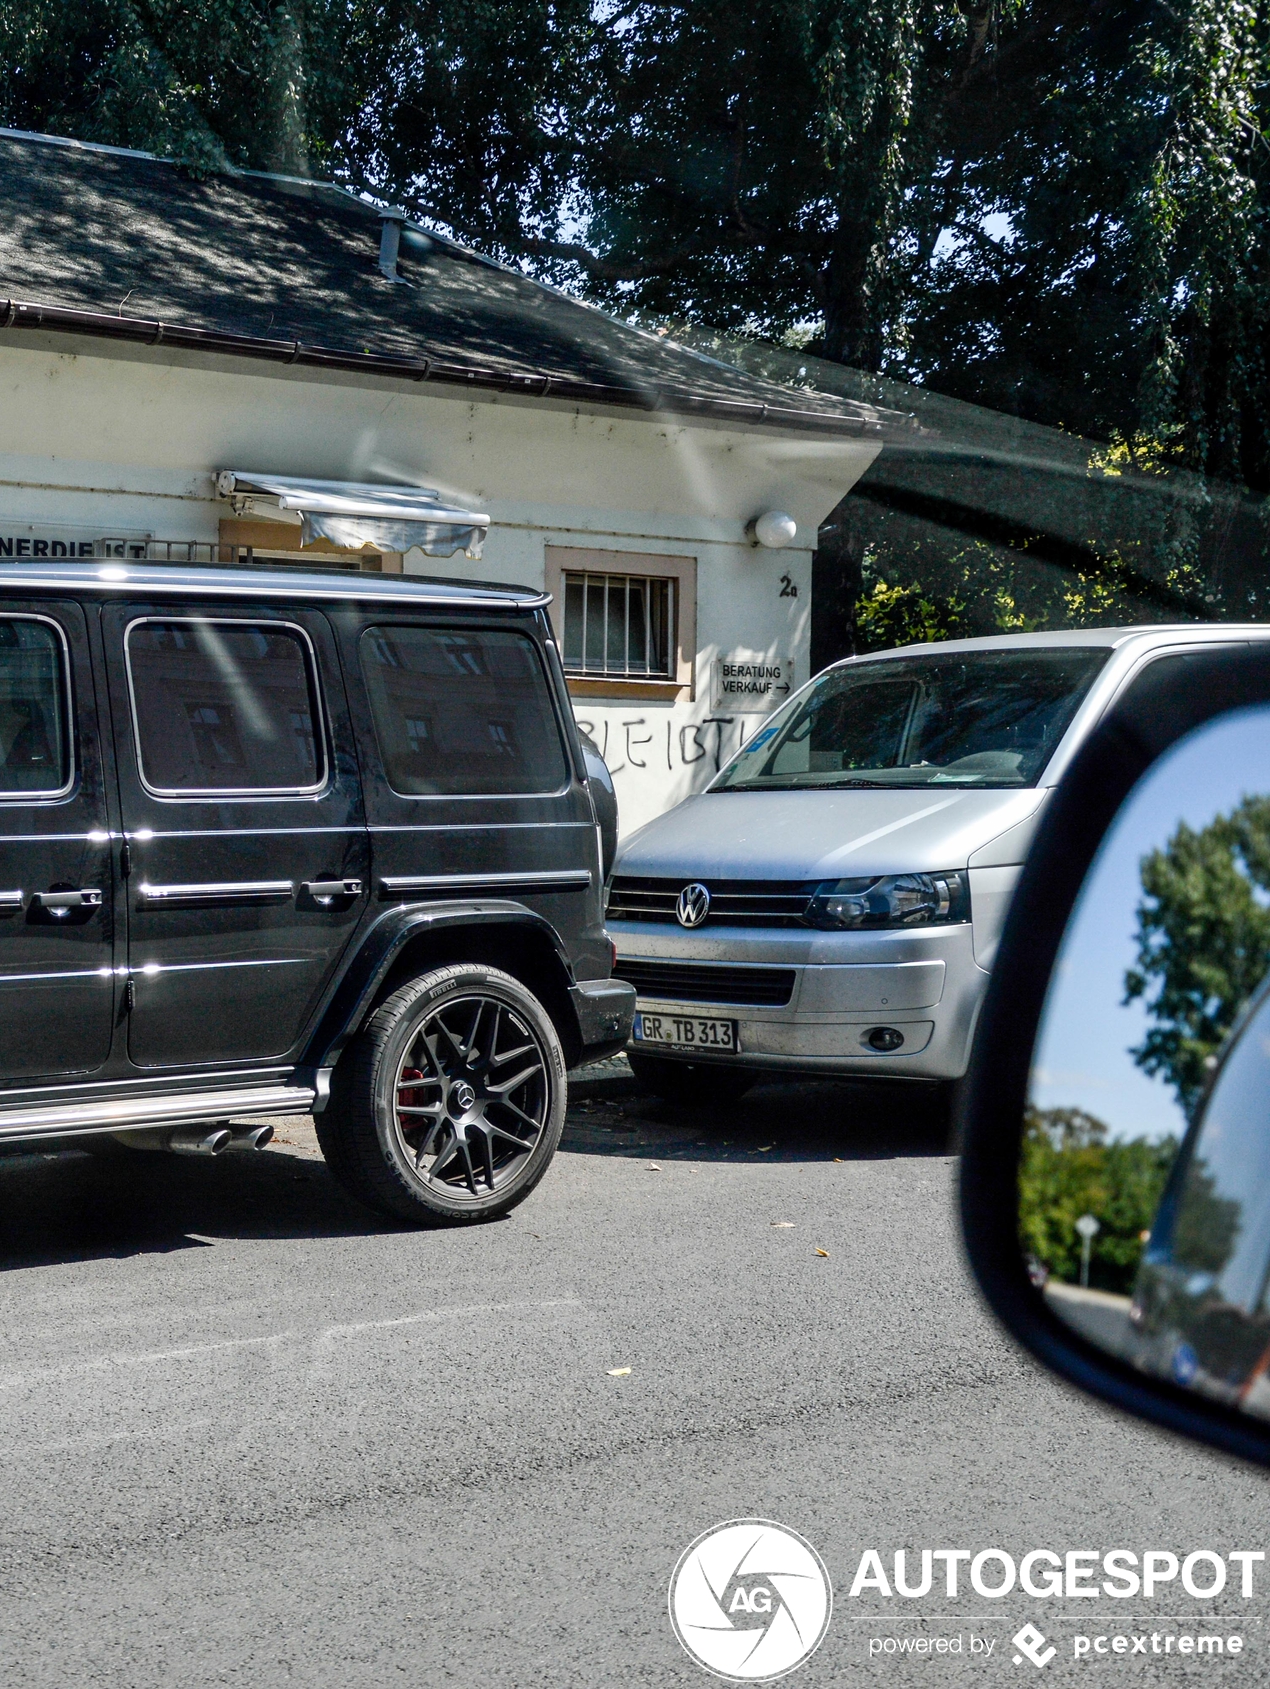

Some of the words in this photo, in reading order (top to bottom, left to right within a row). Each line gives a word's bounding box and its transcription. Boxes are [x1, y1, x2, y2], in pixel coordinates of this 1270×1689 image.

[779, 575, 798, 598] 2a
[722, 664, 781, 679] BERATUNG
[722, 681, 773, 694] VERKAUF
[642, 1016, 664, 1040] GR
[672, 1019, 696, 1043] TB
[698, 1021, 732, 1046] 313
